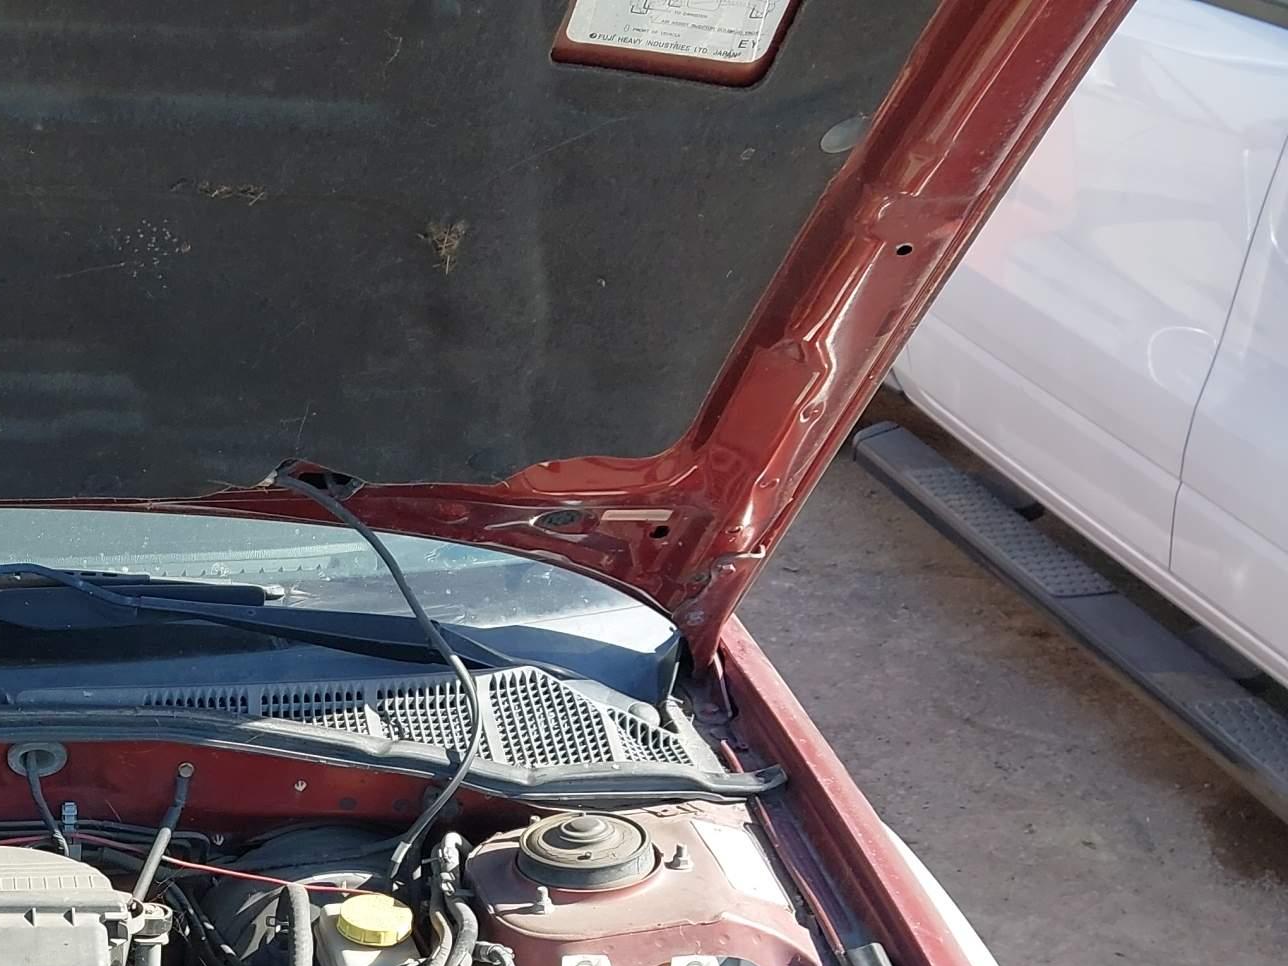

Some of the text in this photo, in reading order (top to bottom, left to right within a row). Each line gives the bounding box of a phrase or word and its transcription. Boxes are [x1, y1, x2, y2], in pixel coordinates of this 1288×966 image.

[597, 32, 616, 41] FUJI
[617, 36, 643, 46] HEAVY
[646, 39, 691, 52] INDUSTRIES
